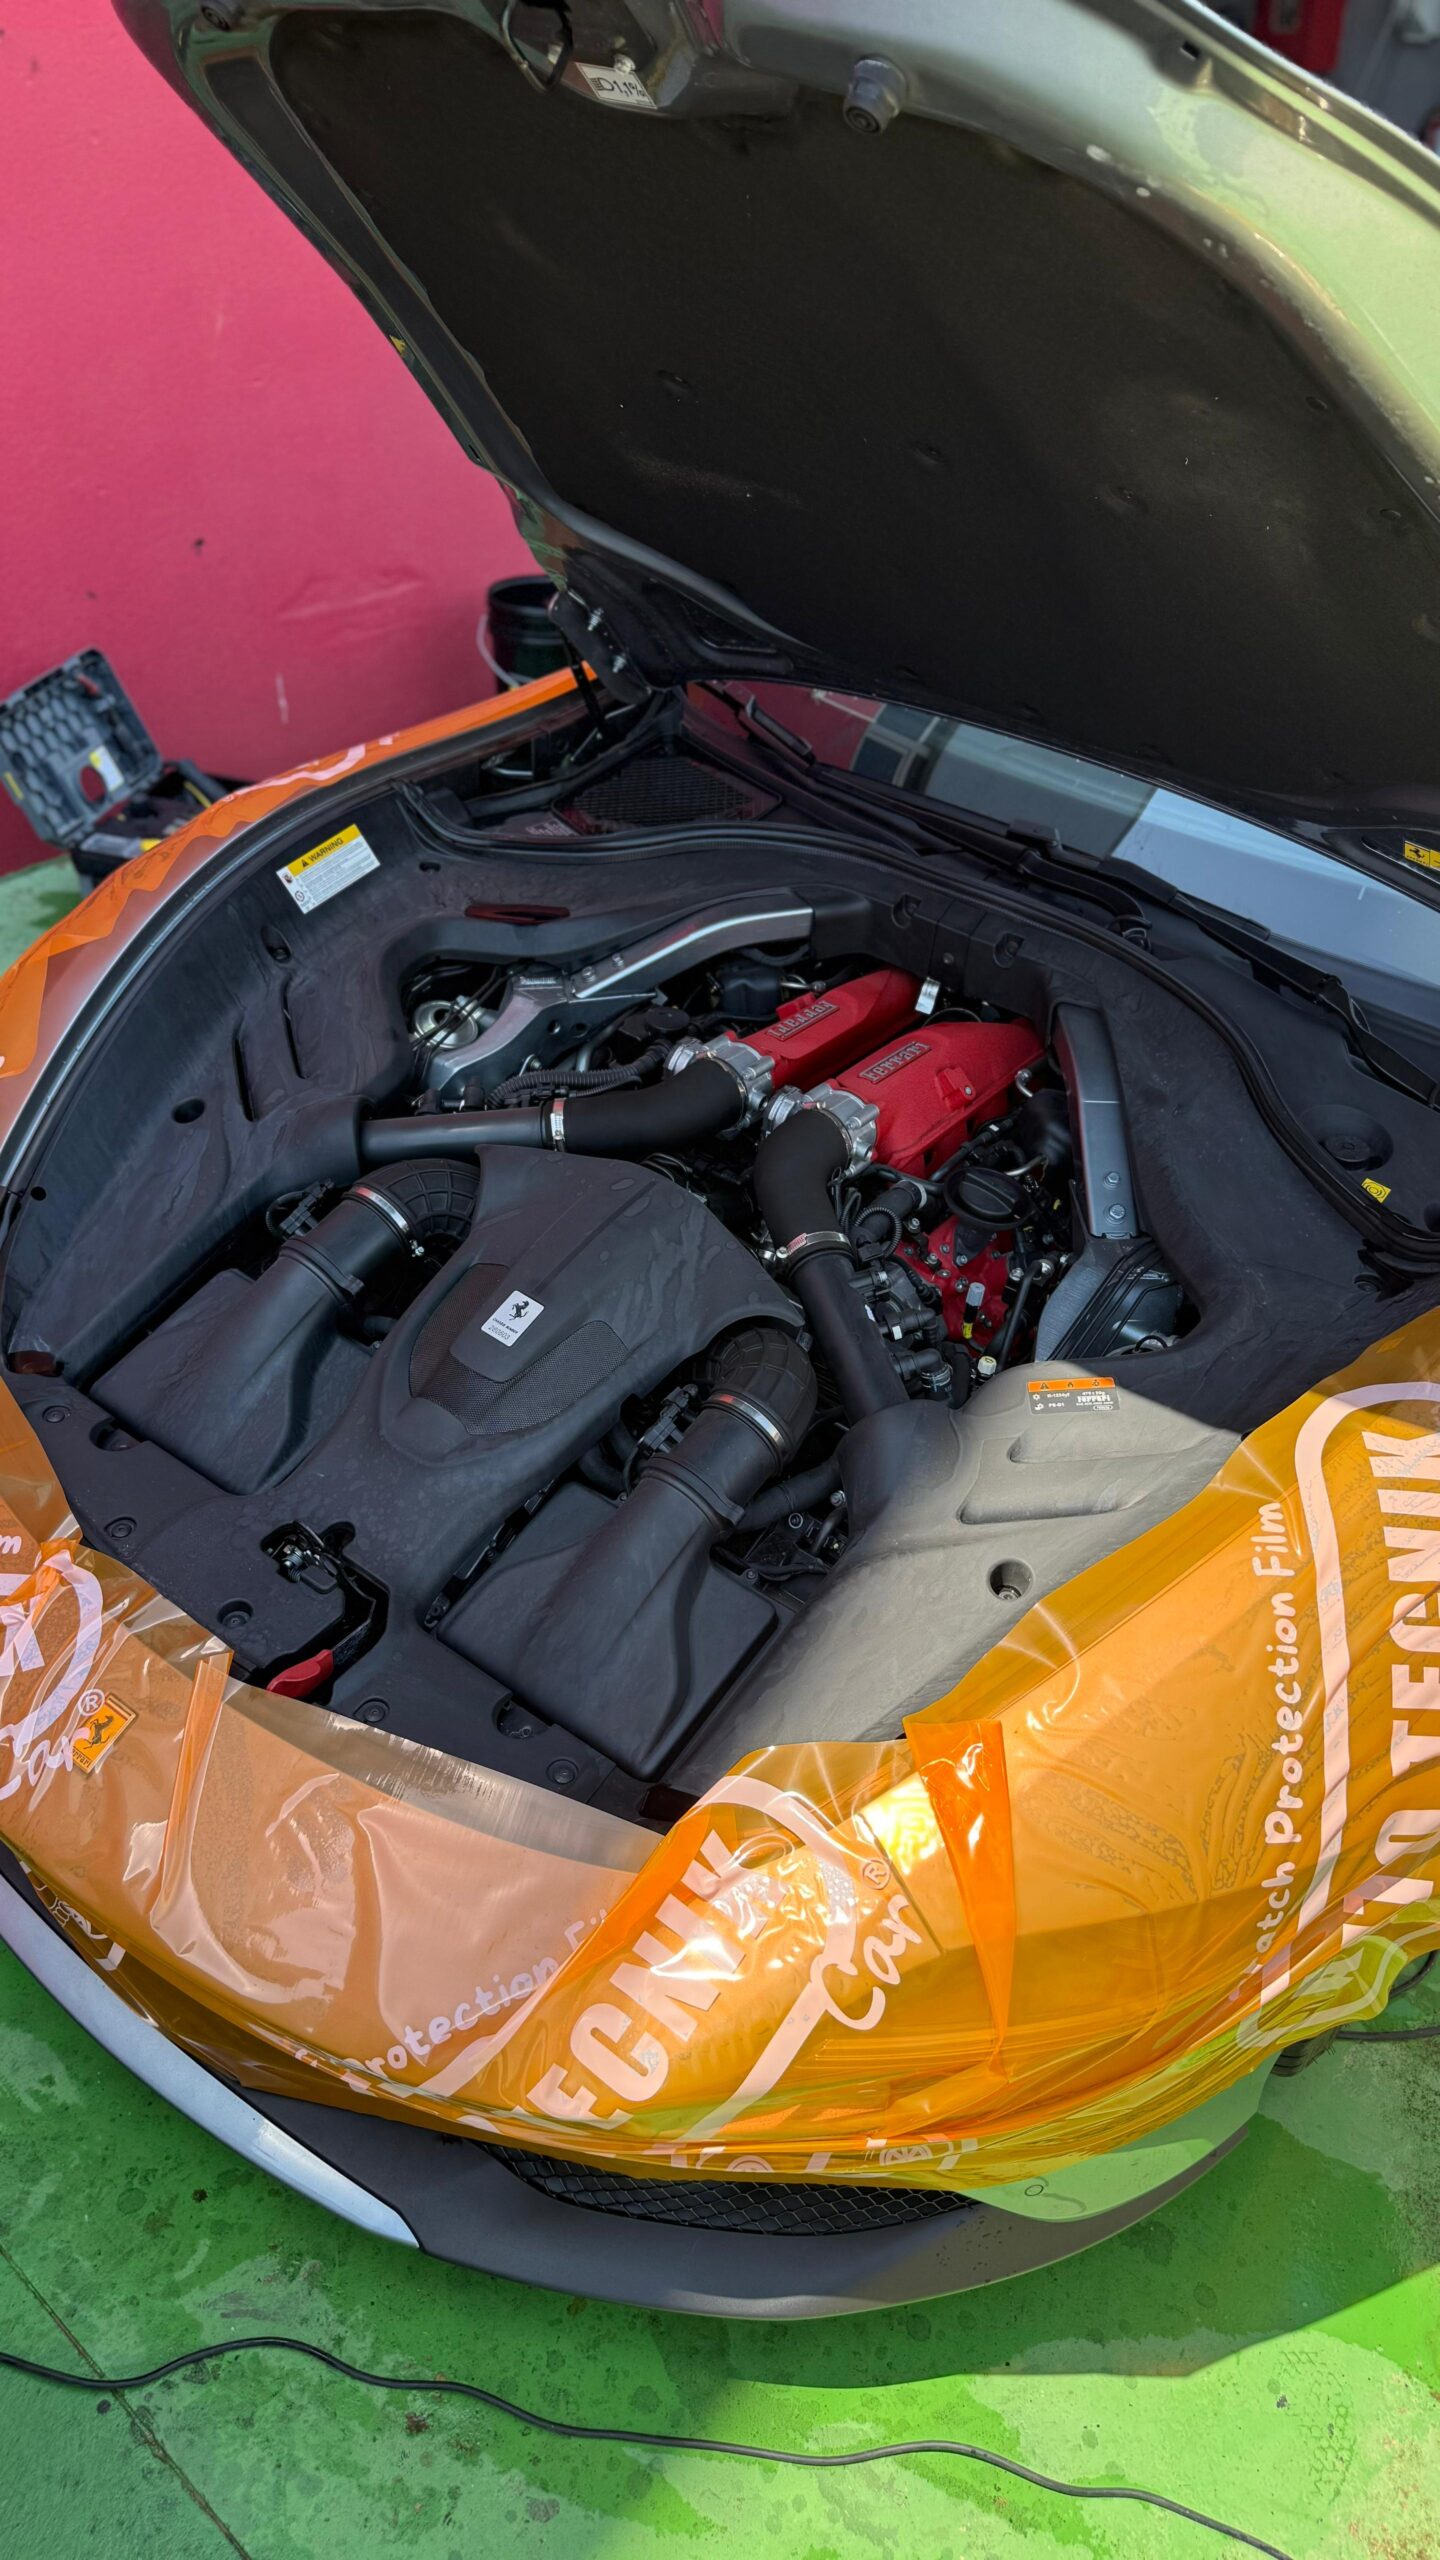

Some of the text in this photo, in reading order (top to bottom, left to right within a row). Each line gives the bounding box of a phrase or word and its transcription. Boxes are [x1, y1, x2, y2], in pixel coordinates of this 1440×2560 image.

[308, 837, 344, 862] WARNING
[862, 1042, 930, 1082] Ferrari
[1249, 1501, 1296, 1578] Film
[1263, 1591, 1304, 1845] Protection
[512, 1829, 787, 2132] ECNIK
[809, 1894, 923, 2032] Car
